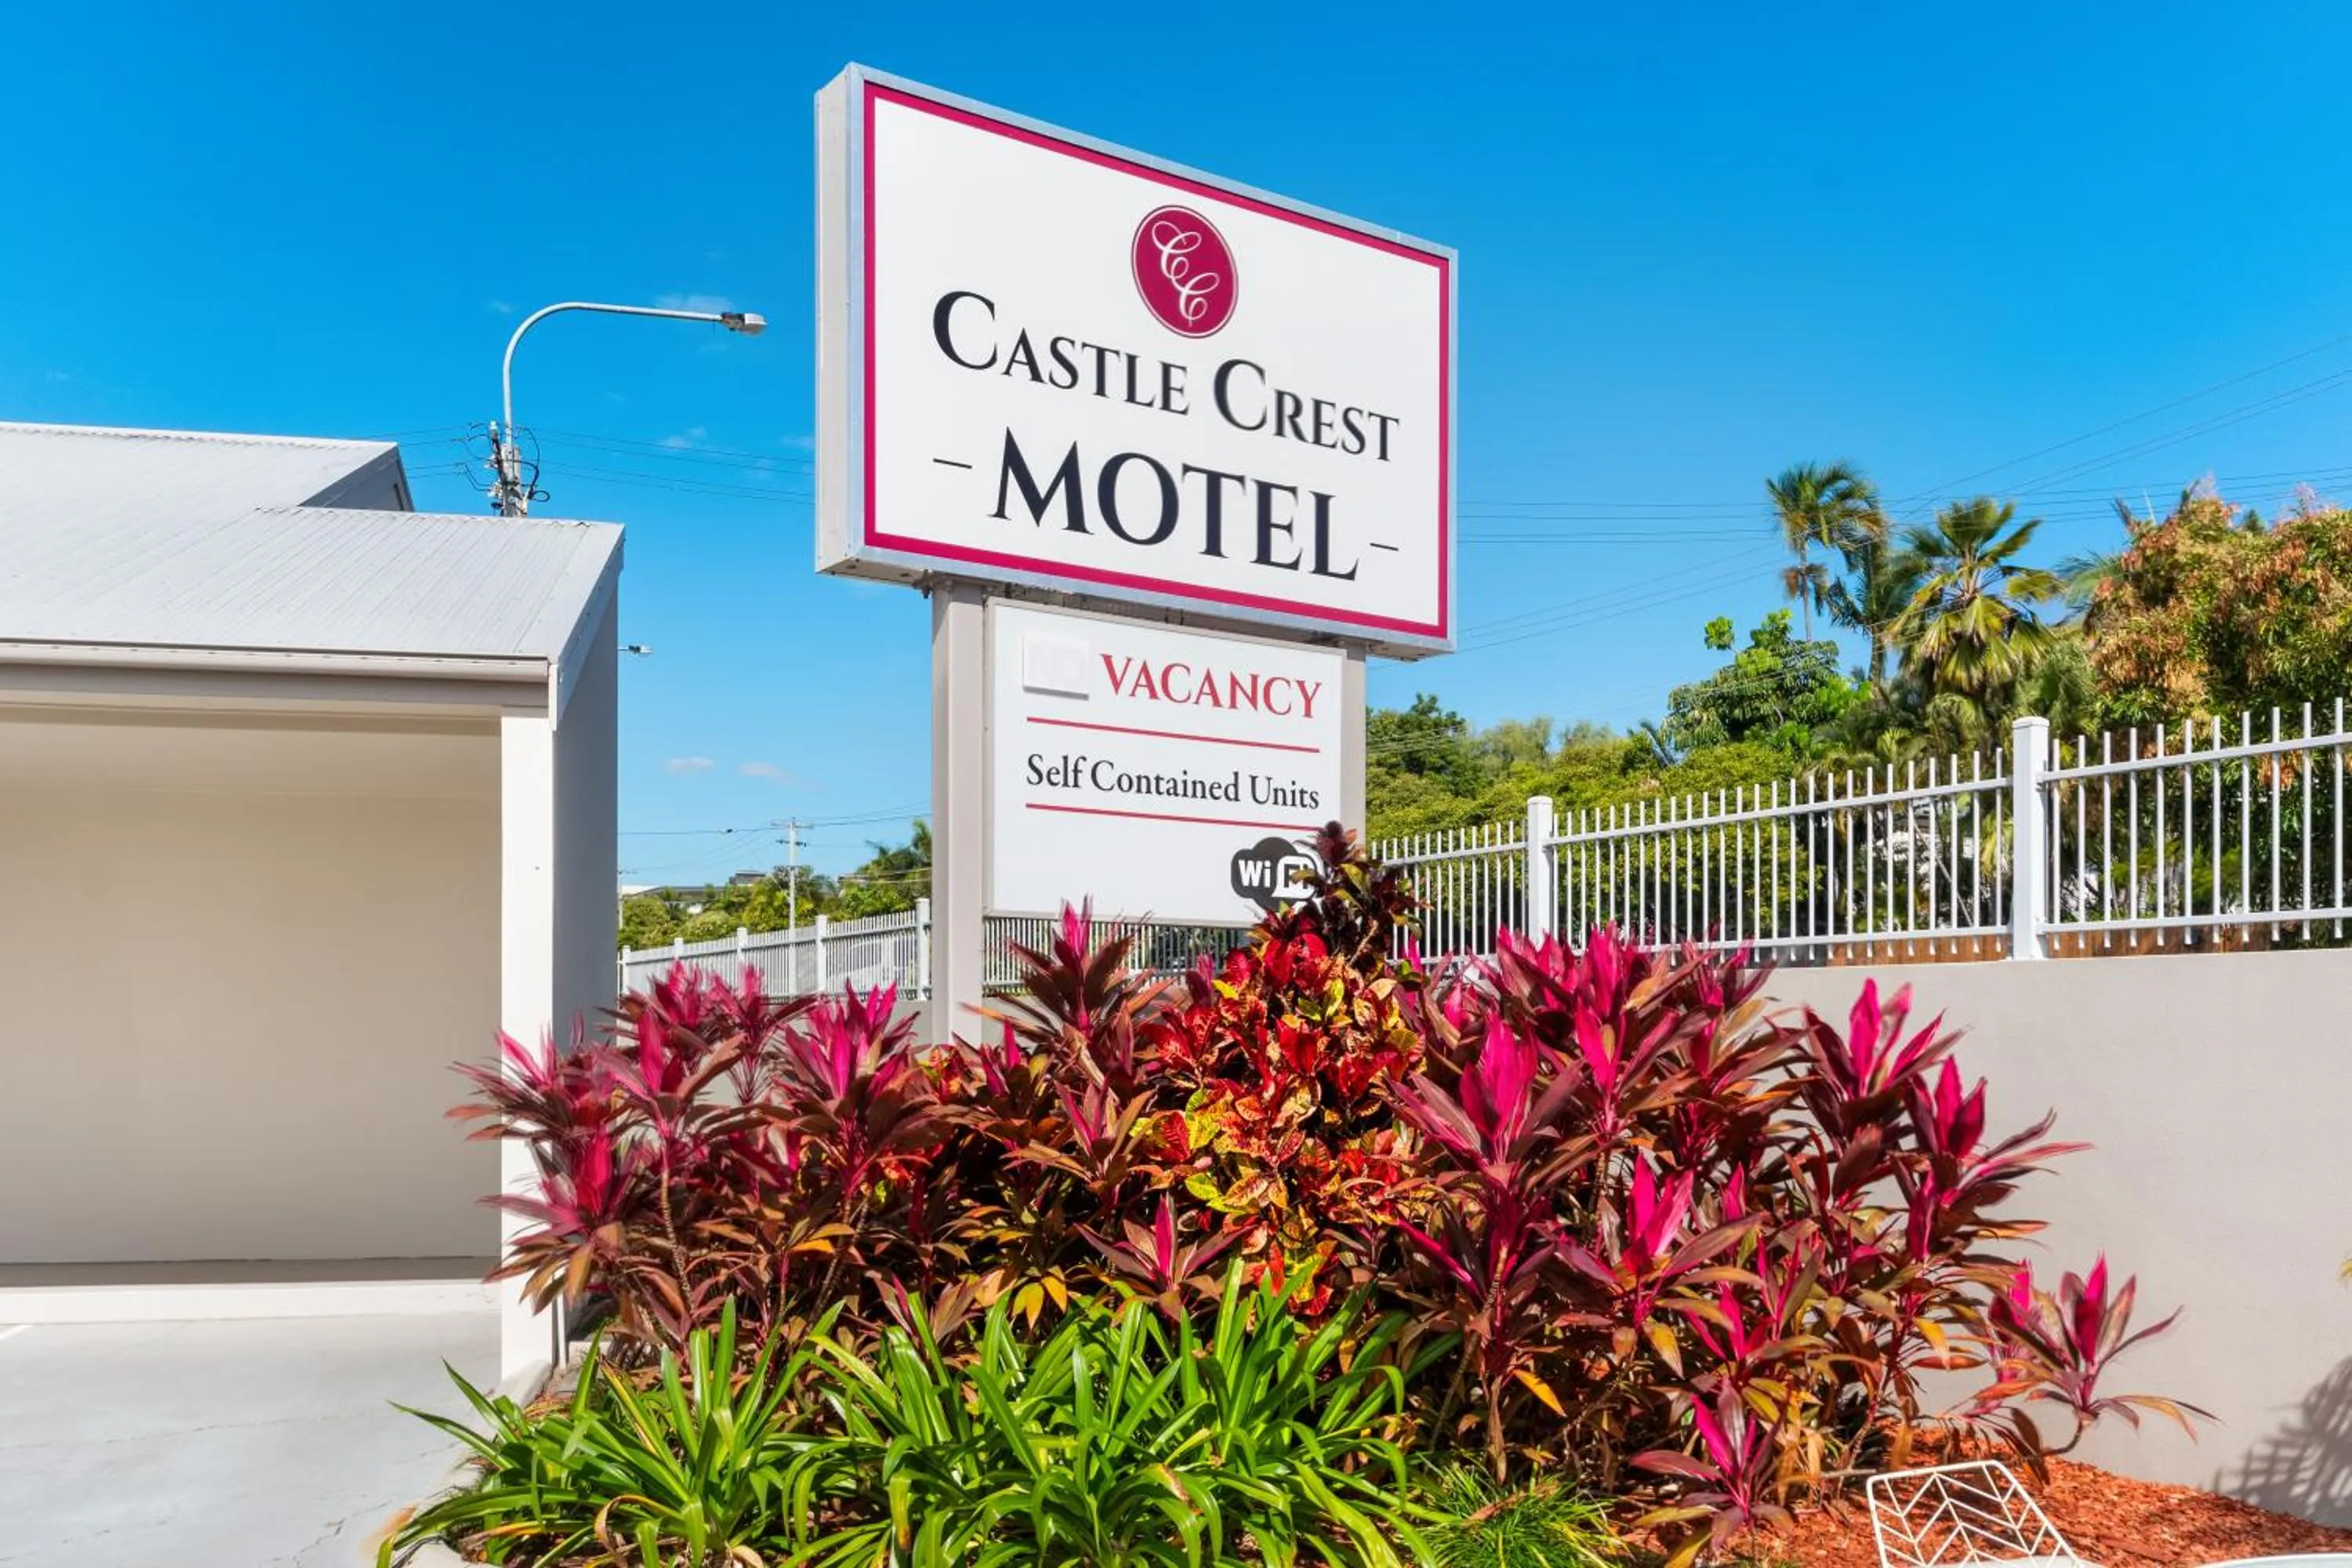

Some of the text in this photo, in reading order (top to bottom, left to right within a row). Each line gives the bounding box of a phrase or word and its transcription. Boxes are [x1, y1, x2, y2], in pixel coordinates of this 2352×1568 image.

[932, 290, 1400, 463] CASTLE CREST
[988, 425, 1359, 582] MOTEL
[1101, 653, 1322, 718] VACANCY
[1025, 753, 1320, 811] Self Contained Units
